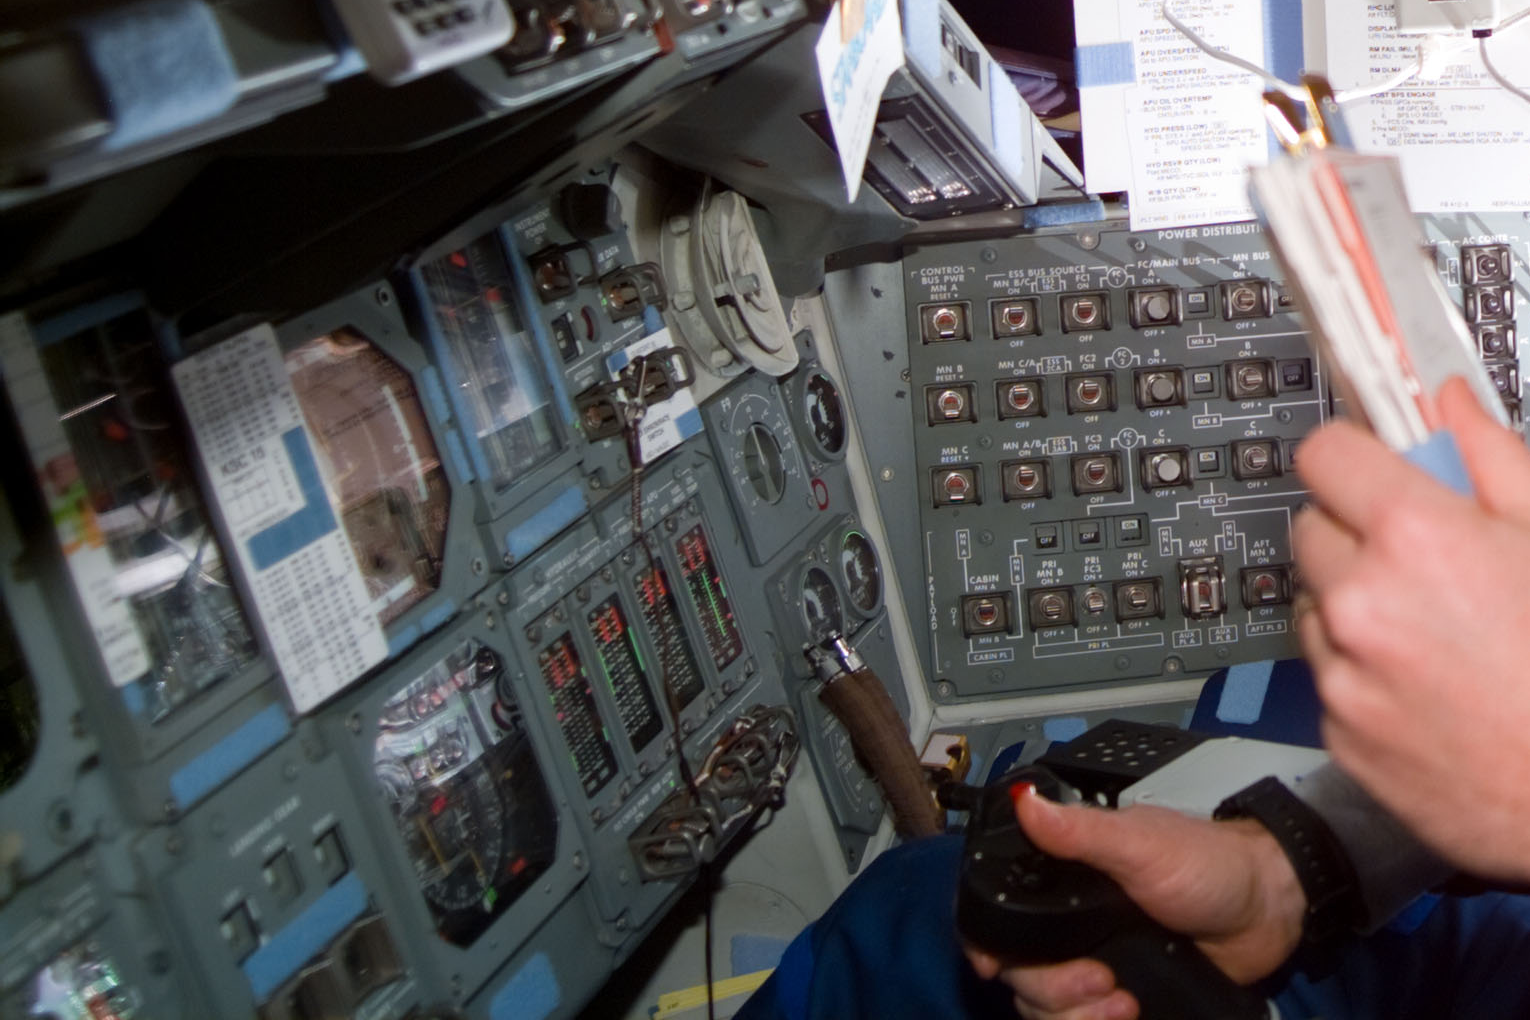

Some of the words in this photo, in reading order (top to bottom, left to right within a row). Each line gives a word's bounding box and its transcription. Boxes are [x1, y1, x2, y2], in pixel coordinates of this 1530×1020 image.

[1157, 46, 1201, 56] OVERSPEED
[1158, 67, 1207, 77] UNDERSPEED
[1143, 98, 1158, 106] APU
[1173, 95, 1213, 103] OVERTEMP
[1144, 126, 1159, 134] HYD
[1161, 124, 1184, 132] PRESS
[1146, 161, 1162, 169] HYD
[1184, 158, 1198, 166] QTY
[525, 222, 547, 240] POWER
[1158, 229, 1198, 240] POWER
[1203, 224, 1262, 237] DISTRIBUTI
[1463, 236, 1475, 245] AC
[1478, 233, 1508, 243] CONTR
[1232, 253, 1249, 262] MN
[1252, 251, 1270, 260] BUS
[1137, 259, 1179, 268] FC/MAIN
[1183, 256, 1201, 266] BUS
[1238, 262, 1246, 270] A
[920, 266, 965, 277] CONTROL
[1008, 270, 1024, 278] ESS
[1028, 269, 1045, 277] BUS
[1049, 265, 1086, 276] SOURCE
[1148, 269, 1155, 277] A
[921, 277, 940, 286] BUS
[944, 275, 965, 283] PWR
[1076, 274, 1090, 282] FC1
[930, 285, 948, 293] MN
[951, 283, 959, 292] A
[993, 280, 1009, 289] MN
[1014, 278, 1031, 287] B/C
[930, 293, 951, 301] RESET
[1079, 335, 1093, 343] OFF
[1191, 338, 1204, 346] MN
[1010, 340, 1024, 348] OFF
[1245, 341, 1251, 350] B
[1153, 348, 1160, 357] B
[1079, 354, 1096, 363] FC2
[1147, 358, 1160, 366] ON
[936, 365, 953, 374] MN
[957, 364, 964, 373] B
[998, 361, 1015, 370] MN
[1018, 359, 1036, 368] C/A
[1013, 368, 1026, 376] ON
[936, 374, 957, 382] RESET
[1241, 402, 1254, 410] OFF
[1150, 410, 1163, 418] OFF
[1084, 416, 1098, 424] OFF
[1249, 421, 1256, 429] C
[1158, 428, 1165, 437] C
[1085, 435, 1102, 444] FC3
[1003, 442, 1019, 451] MN
[1023, 440, 1042, 449] A/B
[942, 447, 958, 456] MN
[961, 445, 969, 454] C
[941, 455, 962, 464] RESET
[1247, 482, 1260, 490] OFF
[1090, 496, 1104, 505] OFF
[1021, 502, 1036, 511] OFF
[1082, 532, 1095, 540] OFF
[1189, 538, 1208, 548] AUX
[1253, 539, 1270, 549] AFT
[1127, 552, 1142, 561] PRI
[1250, 549, 1266, 558] MN
[1269, 547, 1276, 556] B
[1042, 560, 1057, 569] PRI
[1085, 556, 1100, 565] PRI
[1121, 561, 1138, 570] MN
[1141, 559, 1149, 568] C
[1037, 570, 1053, 579] MN
[1057, 568, 1064, 577] B
[1084, 565, 1102, 574] FC3
[1125, 570, 1138, 578] ON
[969, 574, 999, 585] CABIN
[1083, 574, 1096, 582] ON
[974, 584, 988, 592] MN
[990, 583, 997, 591] A
[928, 575, 938, 631] PAYLOAD
[1260, 608, 1274, 616] OFF
[1087, 626, 1100, 634] OFF
[1128, 622, 1142, 630] OFF
[1250, 625, 1264, 633] AFT
[1266, 624, 1275, 632] PL
[1043, 631, 1057, 639] OFF
[1179, 632, 1195, 640] AUX
[1215, 628, 1231, 636] AUX
[978, 637, 992, 645] MN
[973, 652, 998, 661] CABIN
[999, 651, 1007, 659] PL
[230, 818, 273, 858] LANDING
[273, 795, 301, 823] GEAR
